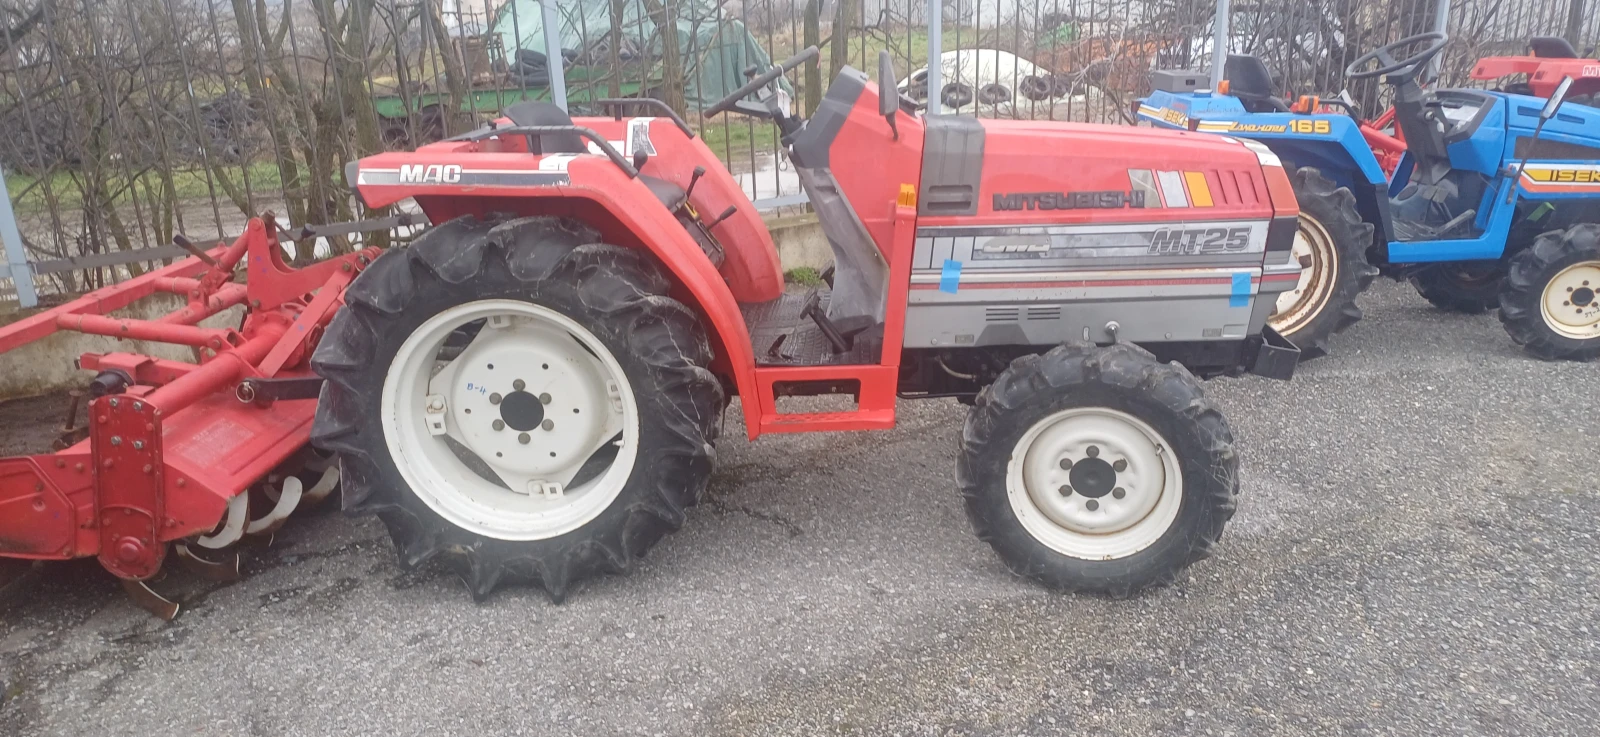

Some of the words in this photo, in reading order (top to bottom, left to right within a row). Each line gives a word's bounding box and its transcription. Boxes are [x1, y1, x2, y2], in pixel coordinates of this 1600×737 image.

[1288, 119, 1331, 134] 165
[399, 164, 462, 183] MAC
[993, 190, 1145, 211] MITSUBISHI
[1148, 227, 1251, 253] MT25
